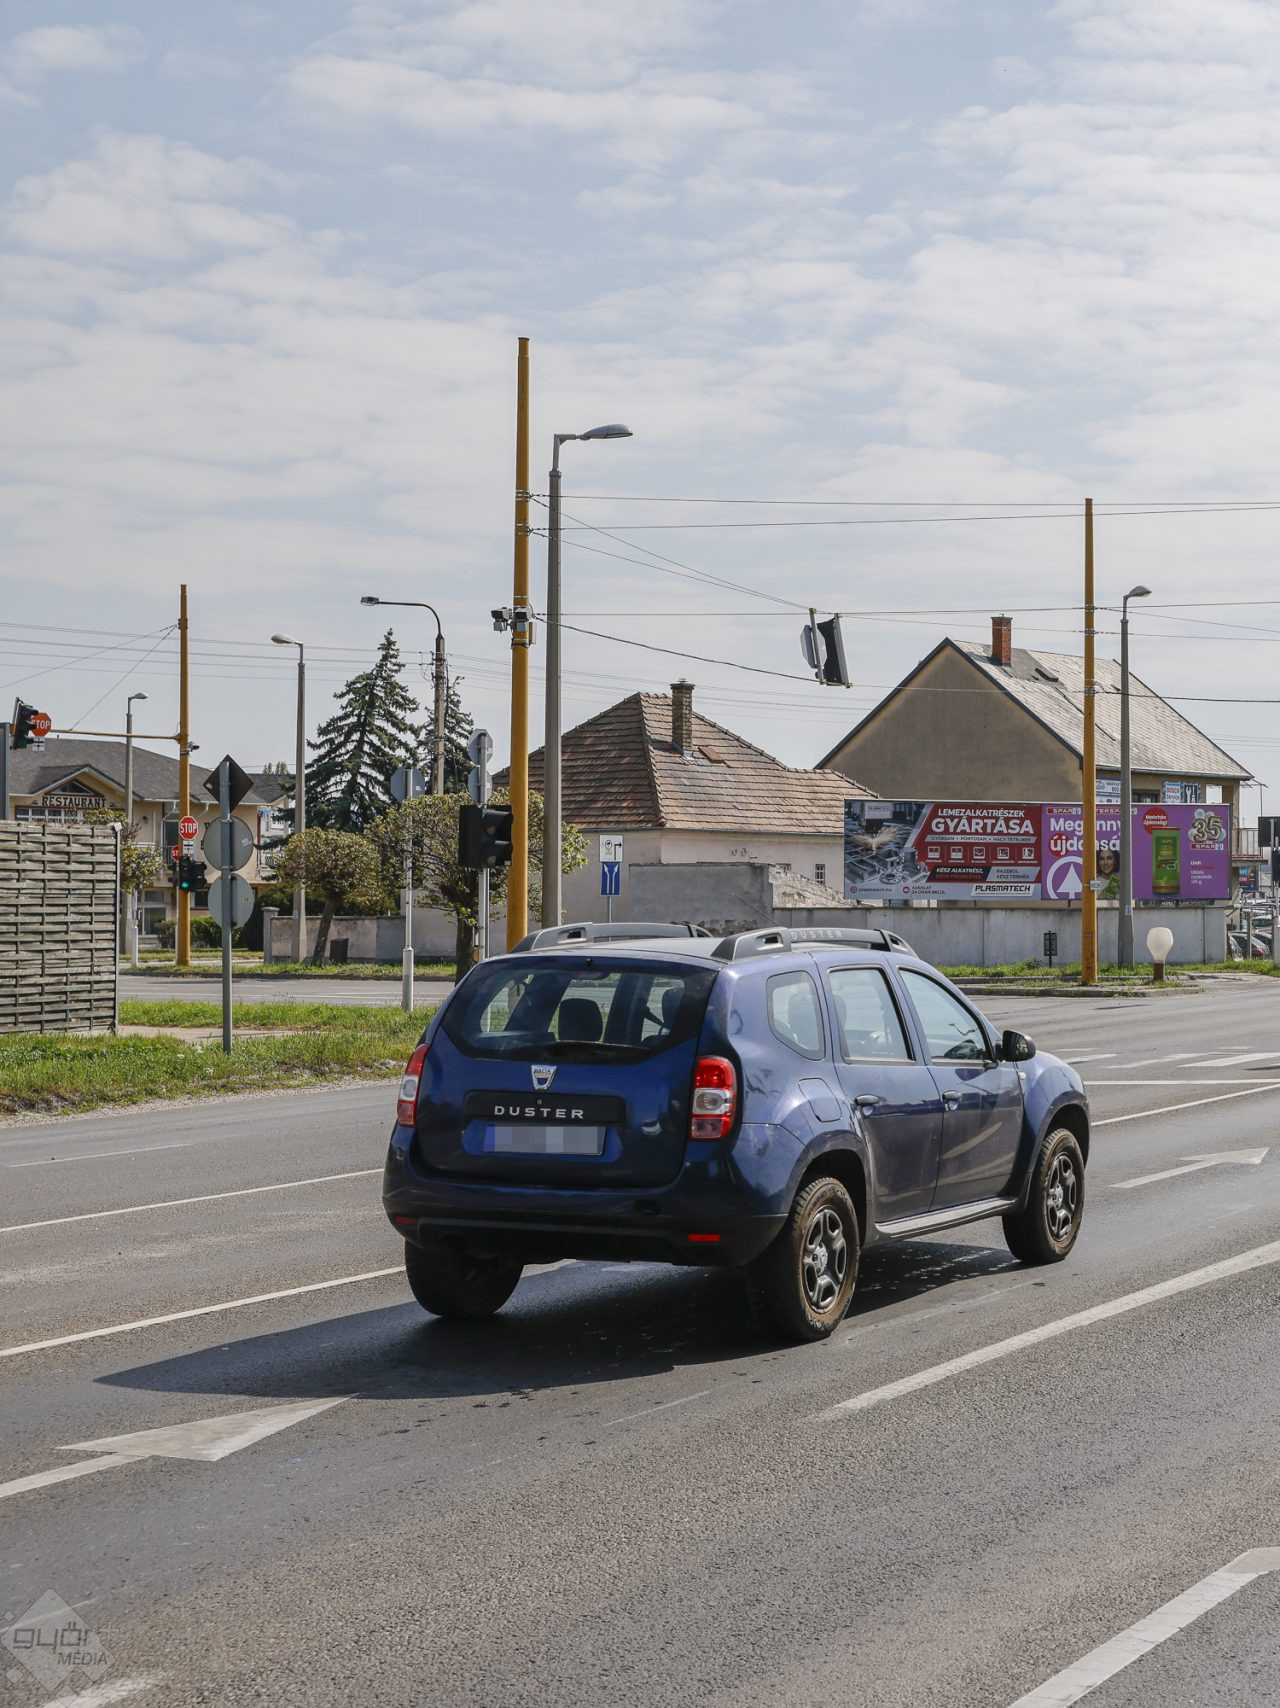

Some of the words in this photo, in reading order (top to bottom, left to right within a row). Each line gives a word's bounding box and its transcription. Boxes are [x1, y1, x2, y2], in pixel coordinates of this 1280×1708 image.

[42, 796, 107, 807] RESTAURANT
[938, 808, 1025, 818] LEMEZALKATRÉSZEK
[180, 823, 197, 833] STOP
[931, 815, 1034, 834] GYÁRTÁSA
[1191, 815, 1222, 843] 35
[974, 884, 1031, 892] PLASMATECH
[790, 930, 843, 940] DUSTER
[494, 1105, 584, 1119] DUSTER
